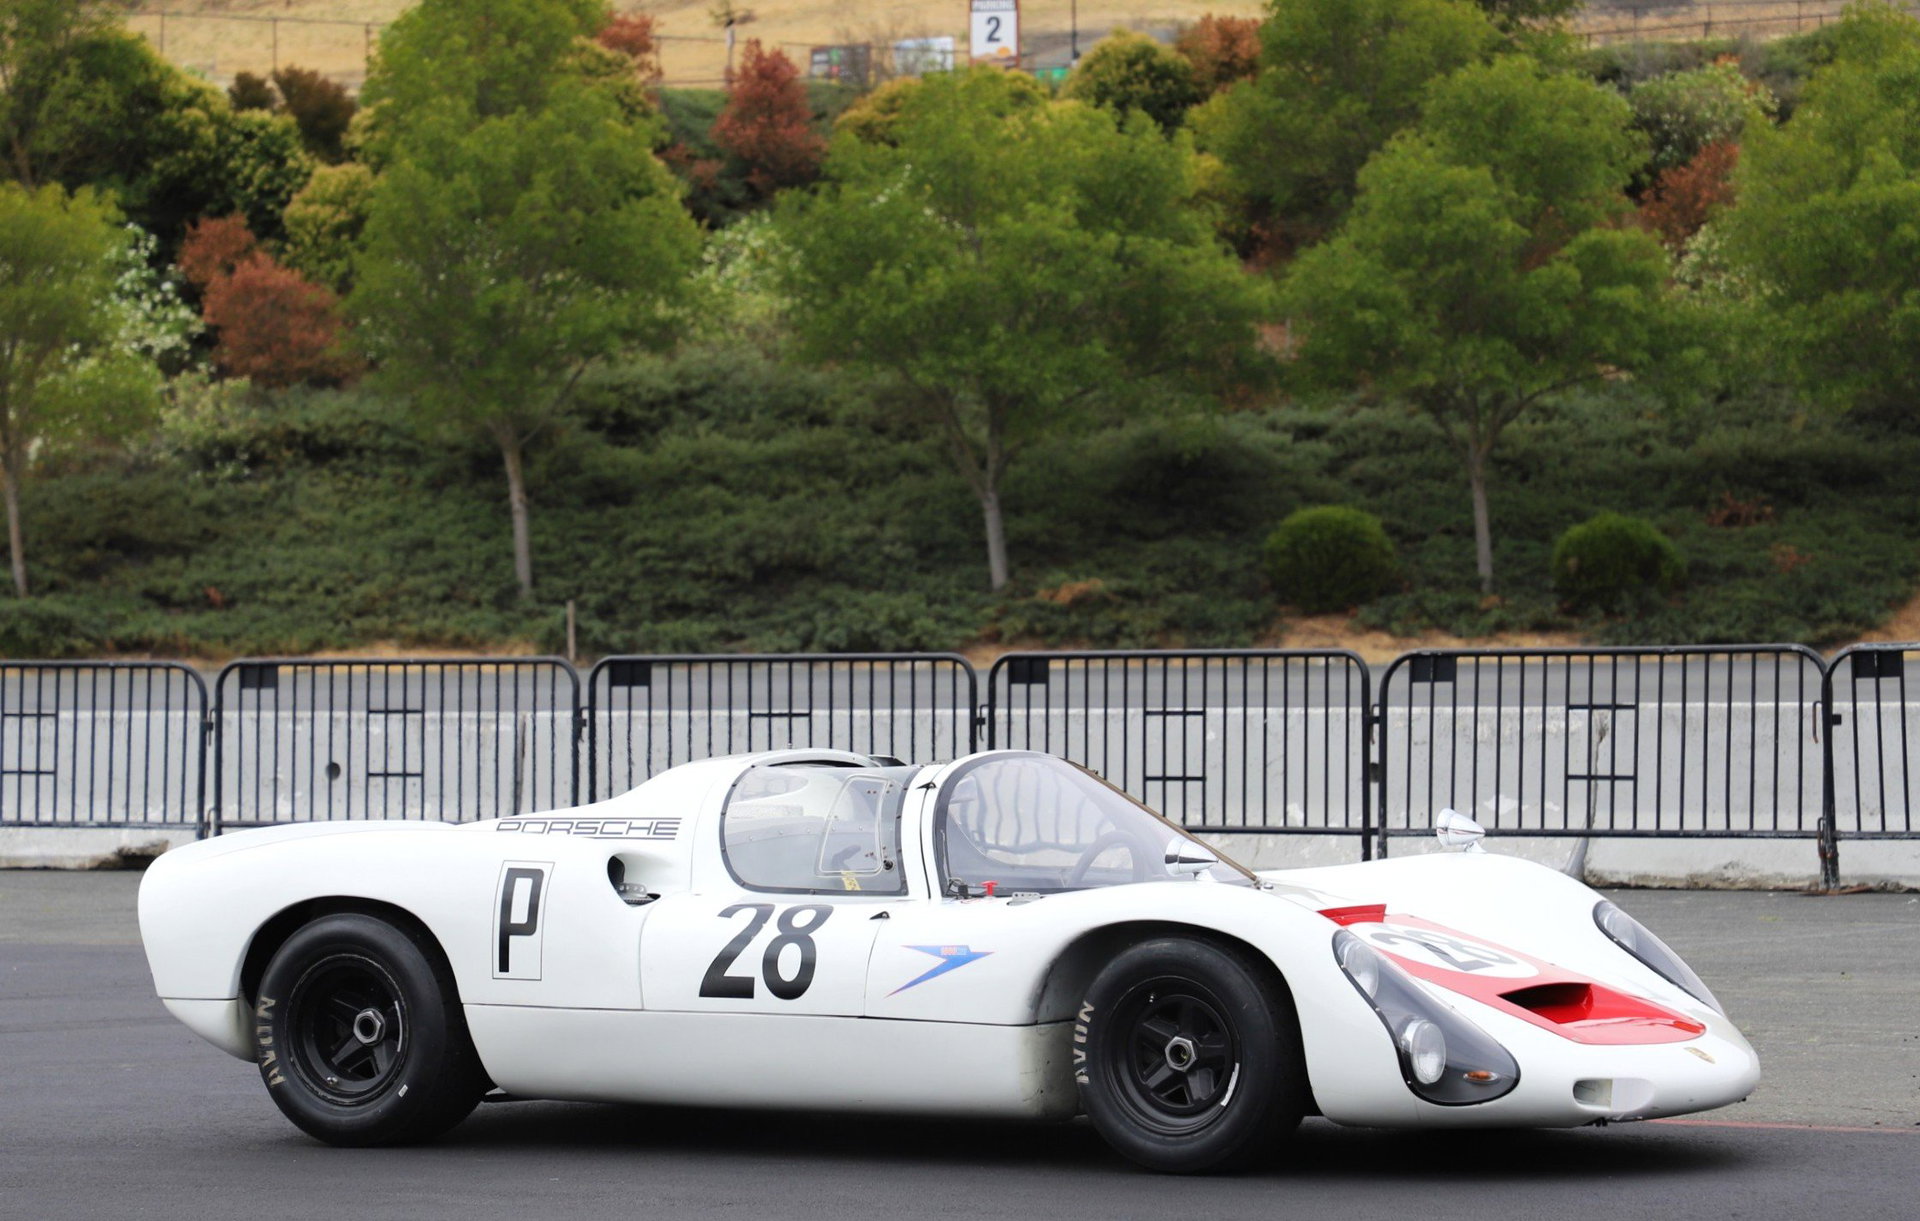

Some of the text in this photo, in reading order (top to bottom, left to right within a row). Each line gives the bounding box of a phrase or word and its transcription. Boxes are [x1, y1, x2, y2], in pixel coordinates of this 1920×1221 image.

[986, 16, 1001, 42] 2
[496, 820, 681, 836] PORSCHE
[498, 867, 545, 973] P
[698, 902, 835, 1001] 28
[1370, 929, 1518, 972] 28
[1073, 1000, 1095, 1084] AVON
